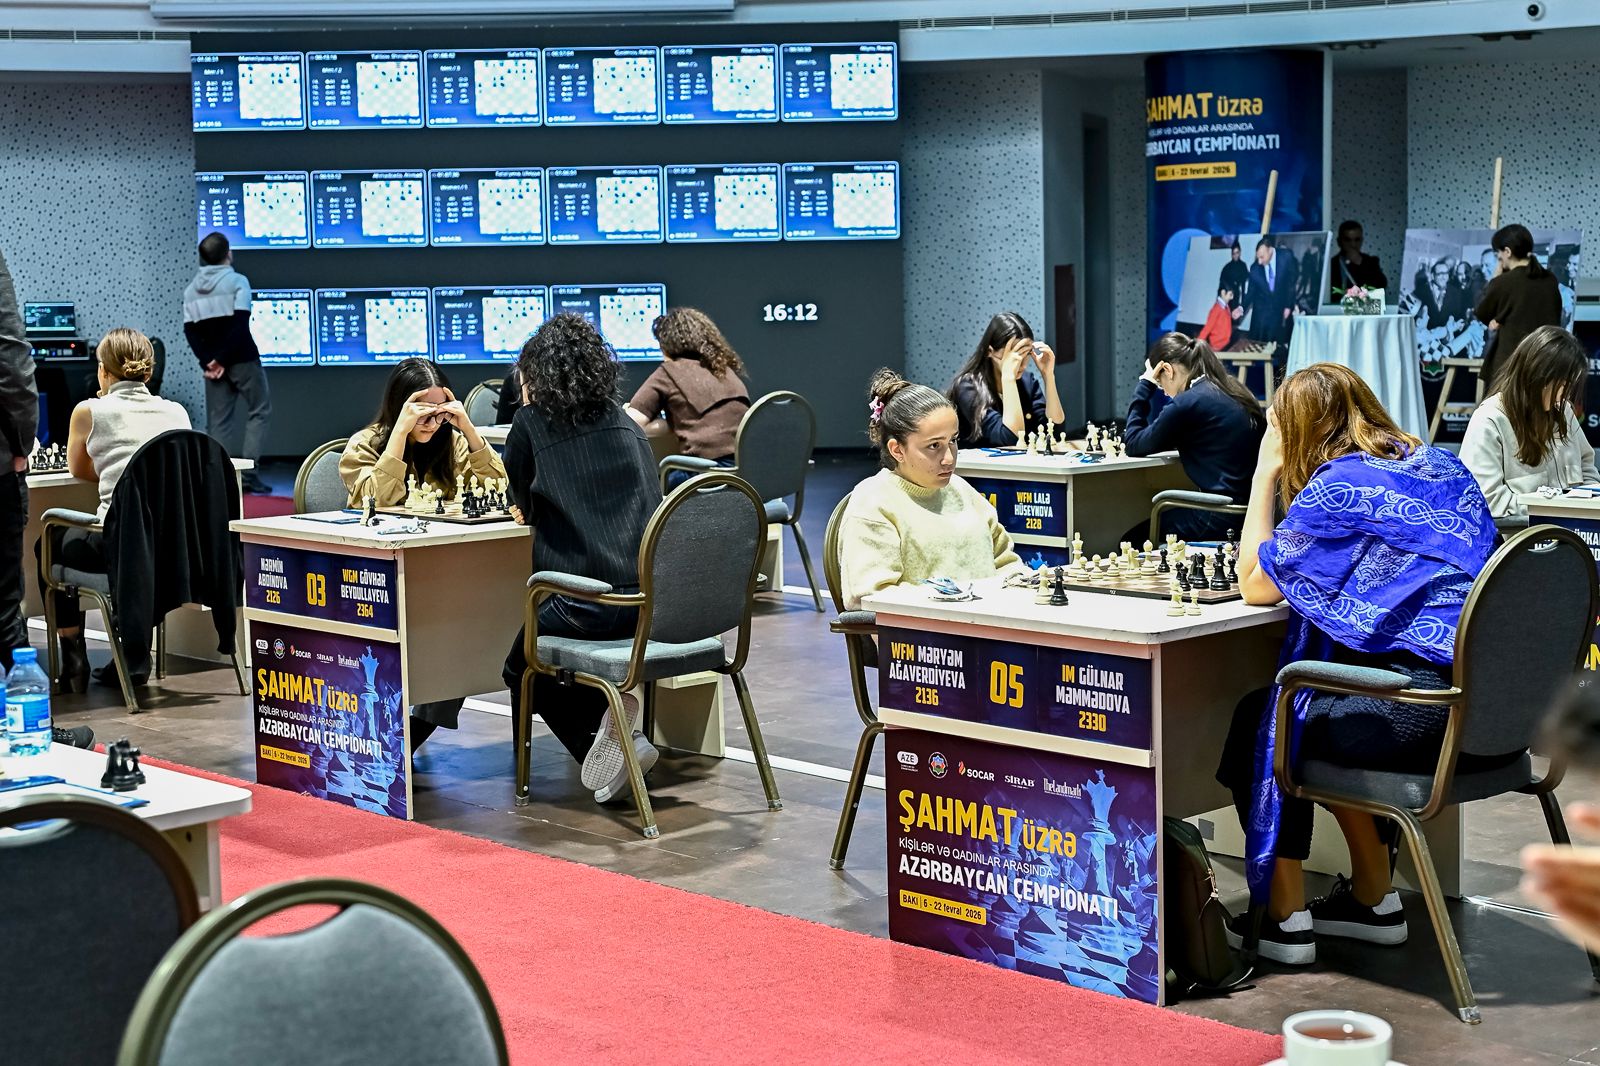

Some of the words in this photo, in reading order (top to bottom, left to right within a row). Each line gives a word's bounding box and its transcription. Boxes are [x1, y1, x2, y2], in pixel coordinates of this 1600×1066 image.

[1217, 95, 1263, 117] ÜZRƏ
[1194, 132, 1280, 155] ÇEMPİONATI
[763, 303, 818, 321] 16:12
[1016, 492, 1032, 503] WFM
[1034, 492, 1050, 504] LALƏ
[1014, 503, 1053, 518] HÜSEYNOVA
[1026, 518, 1042, 530] 2128
[260, 558, 284, 574] NƏRMİN
[258, 572, 288, 590] ABDİNOVA
[342, 568, 358, 583] WGM
[360, 569, 386, 587] GÖVHƏR
[266, 590, 280, 604] 2126
[306, 572, 326, 606] 03
[340, 584, 389, 604] BEYDULLAYEVA
[356, 603, 374, 618] 2364
[295, 650, 312, 659] SOCAR
[891, 642, 914, 661] WFM
[918, 646, 962, 668] MƏRYƏM
[890, 660, 966, 689] AĞAVERDİYEVA
[1062, 664, 1075, 683] IM
[1079, 664, 1124, 690] GÜLNAR
[257, 668, 324, 706] ŞAHMAT
[328, 686, 358, 714] ÜZRƏ
[990, 661, 1024, 709] 05
[916, 686, 939, 706] 2136
[1056, 685, 1130, 714] MƏMMƏDOVA
[258, 704, 279, 716] KİŞİLƏR
[280, 710, 289, 718] VƏ
[289, 712, 317, 724] QADINLAR
[1079, 711, 1106, 732] 2330
[259, 718, 320, 744] AZƏRBAYCAN
[324, 731, 382, 756] ÇEMPİONATI
[900, 754, 914, 763] AZE
[967, 768, 995, 781] SOCAR
[899, 789, 1017, 845] ŞAHMAT
[1023, 818, 1077, 859] ÜZRƏ
[899, 837, 935, 855] KİŞİLƏR
[936, 845, 950, 857] VƏ
[952, 849, 1000, 868] QADINLAR
[1003, 859, 1054, 878] ARASINDA
[899, 854, 1008, 896] AZƏRBAYCAN
[1014, 878, 1118, 920] ÇEMPİONATI
[902, 894, 918, 905] BAKI
[924, 899, 928, 908] 6
[934, 901, 942, 910] 22
[943, 902, 962, 916] fevral
[965, 908, 982, 920] 2026
